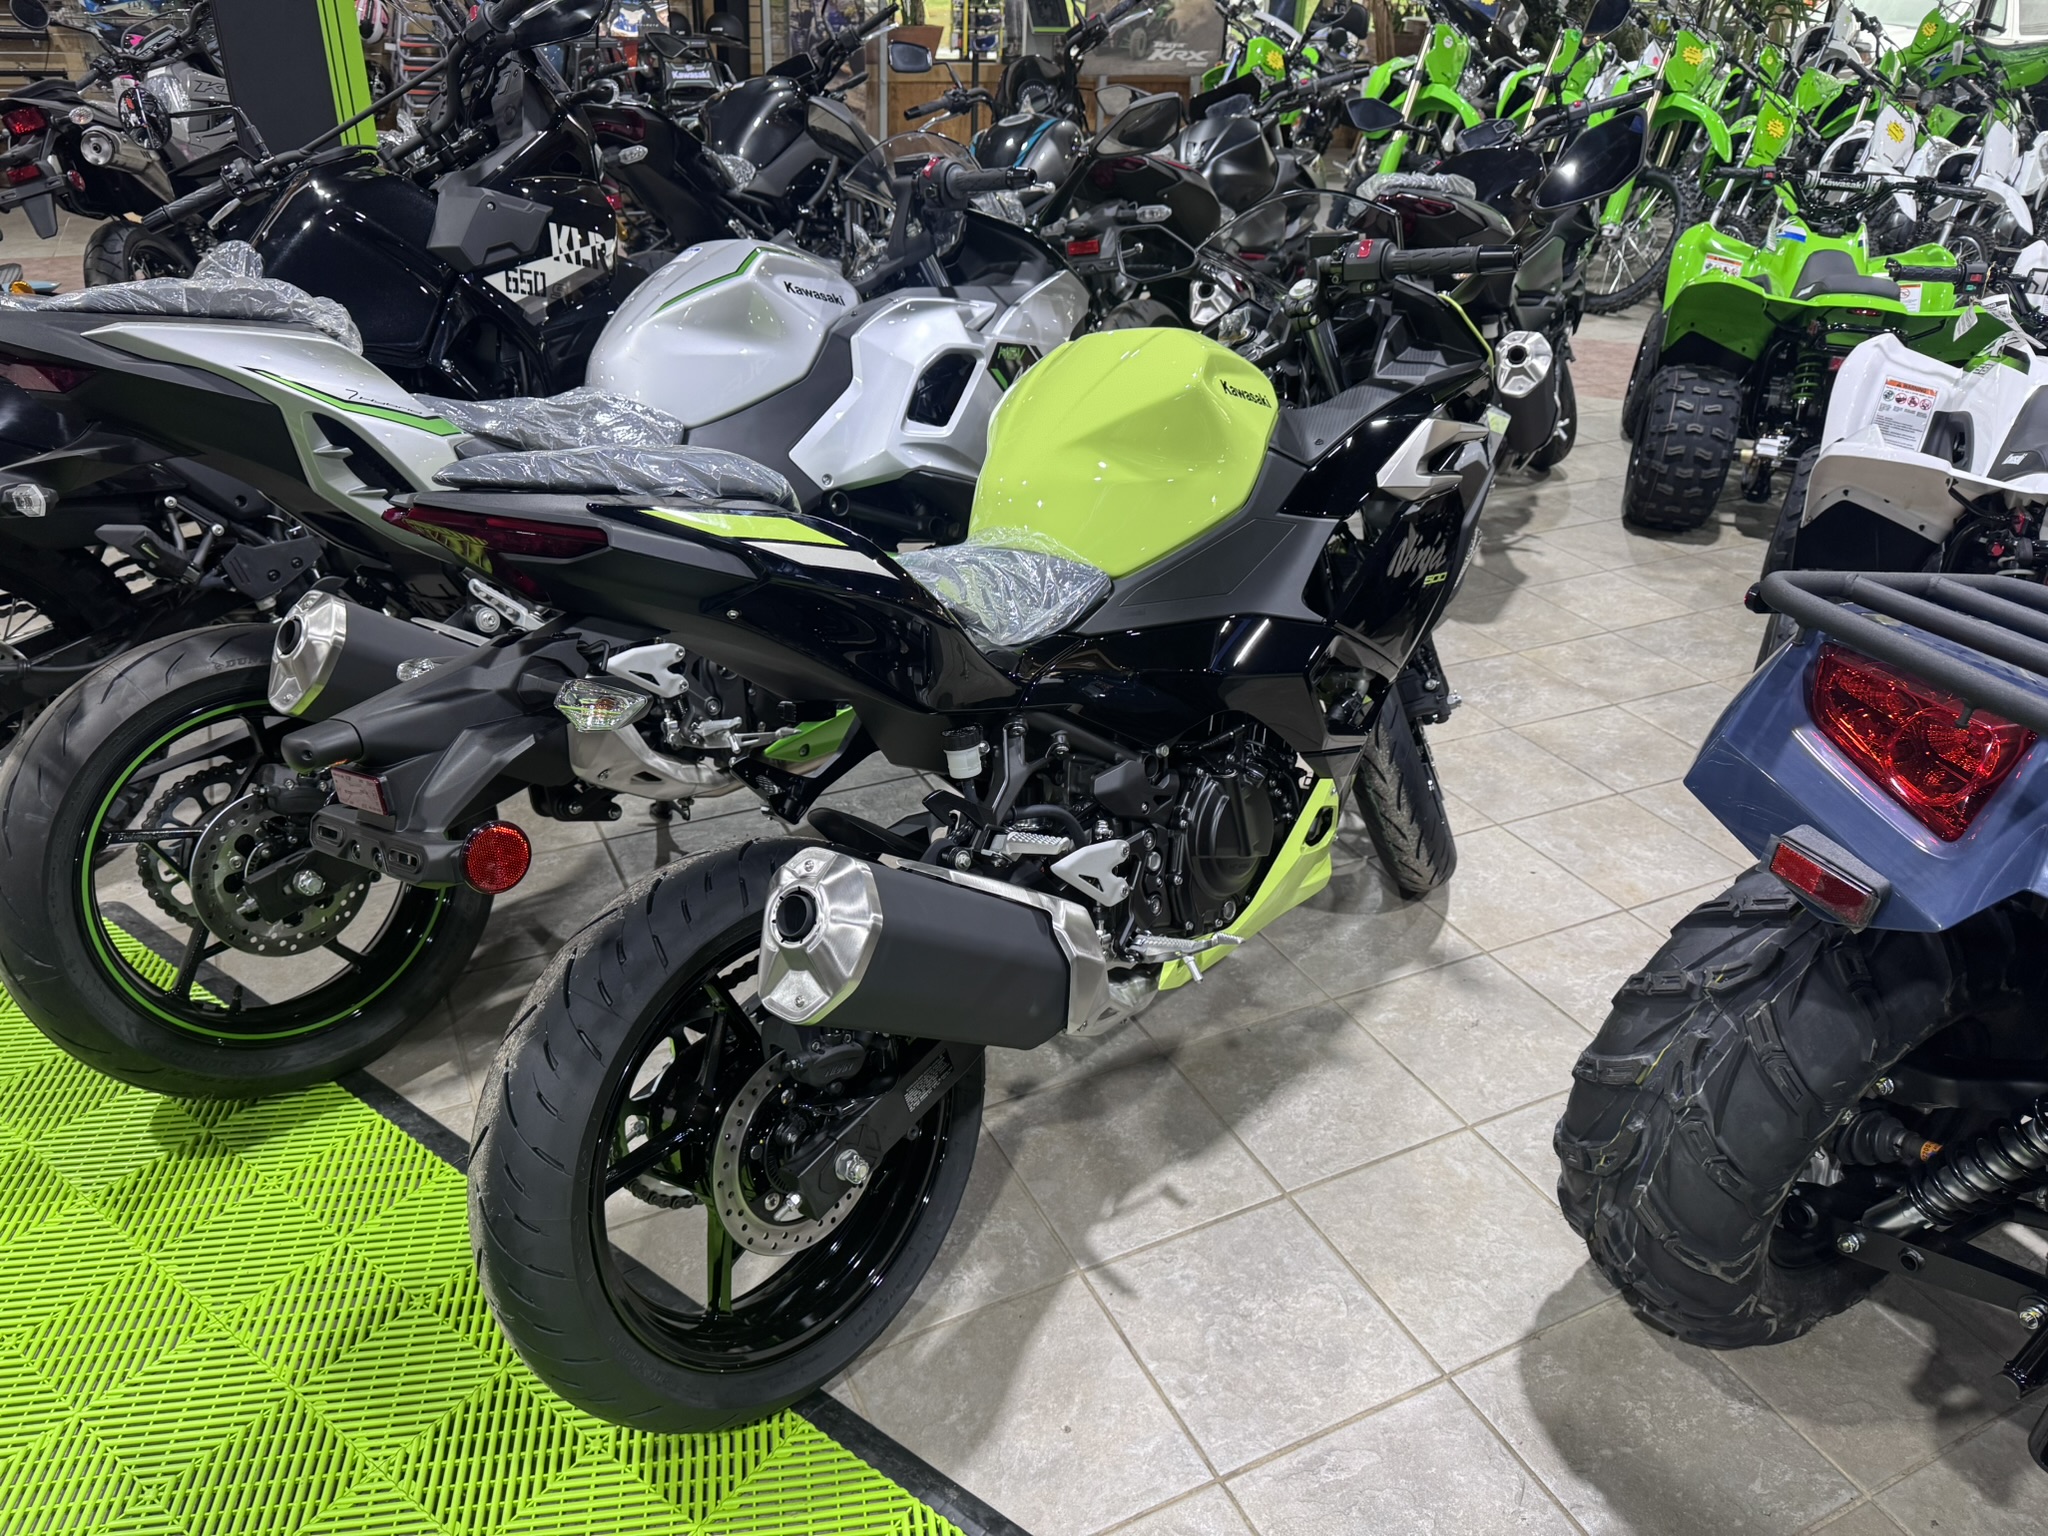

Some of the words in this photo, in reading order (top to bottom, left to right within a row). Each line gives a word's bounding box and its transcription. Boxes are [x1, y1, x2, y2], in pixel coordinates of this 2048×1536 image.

[1147, 48, 1208, 61] KRX
[671, 70, 711, 80] Kawasaki
[1820, 177, 1866, 190] Kawasaki
[548, 222, 610, 273] KLR
[505, 268, 548, 298] 650
[783, 280, 846, 307] Kawasaki
[1219, 379, 1272, 408] Kawasaki
[1386, 522, 1448, 588] Ninja
